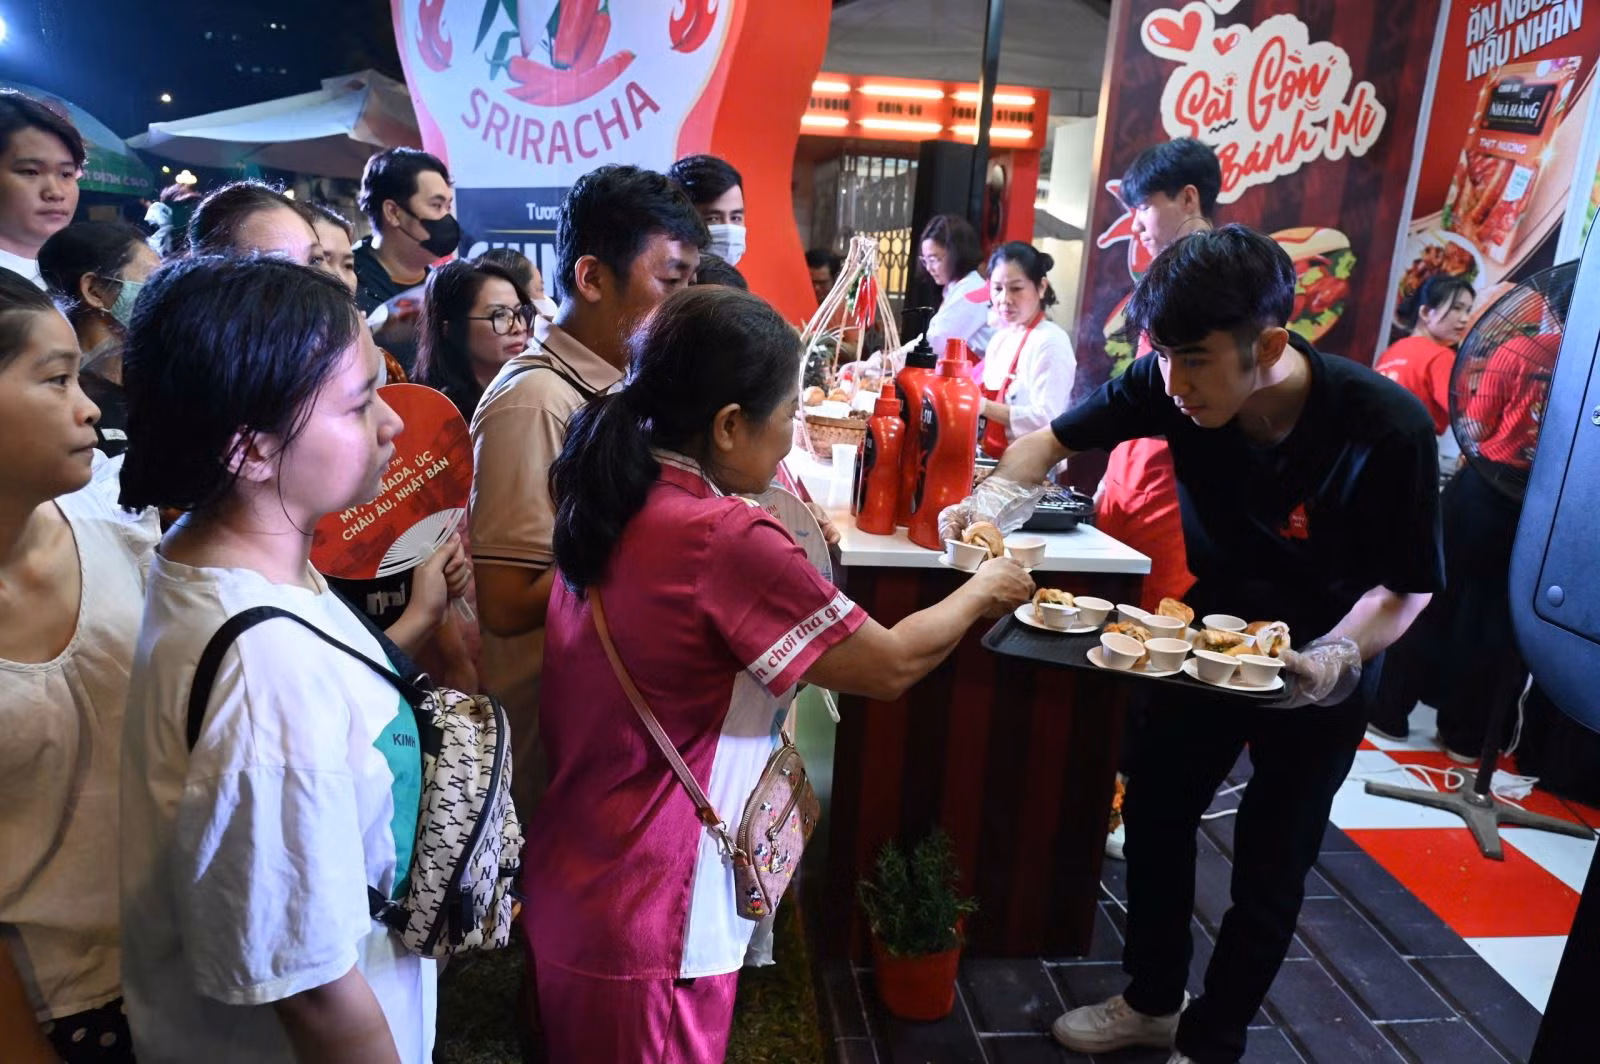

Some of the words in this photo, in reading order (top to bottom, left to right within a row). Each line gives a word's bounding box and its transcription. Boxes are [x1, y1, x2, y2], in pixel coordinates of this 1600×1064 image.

[1466, 2, 1497, 48] ĂN
[1466, 28, 1512, 81] NẤU
[461, 81, 661, 165] SRIRACHA
[1175, 70, 1237, 139] Sài
[1247, 36, 1331, 132] Gòn
[1218, 109, 1318, 192] Bánh
[1330, 88, 1377, 150] Mì
[342, 512, 375, 541] CHÂU
[375, 499, 398, 517] ÂU,
[395, 474, 425, 502] NHẬT
[425, 457, 449, 479] BẢN
[414, 450, 433, 467] ÚC
